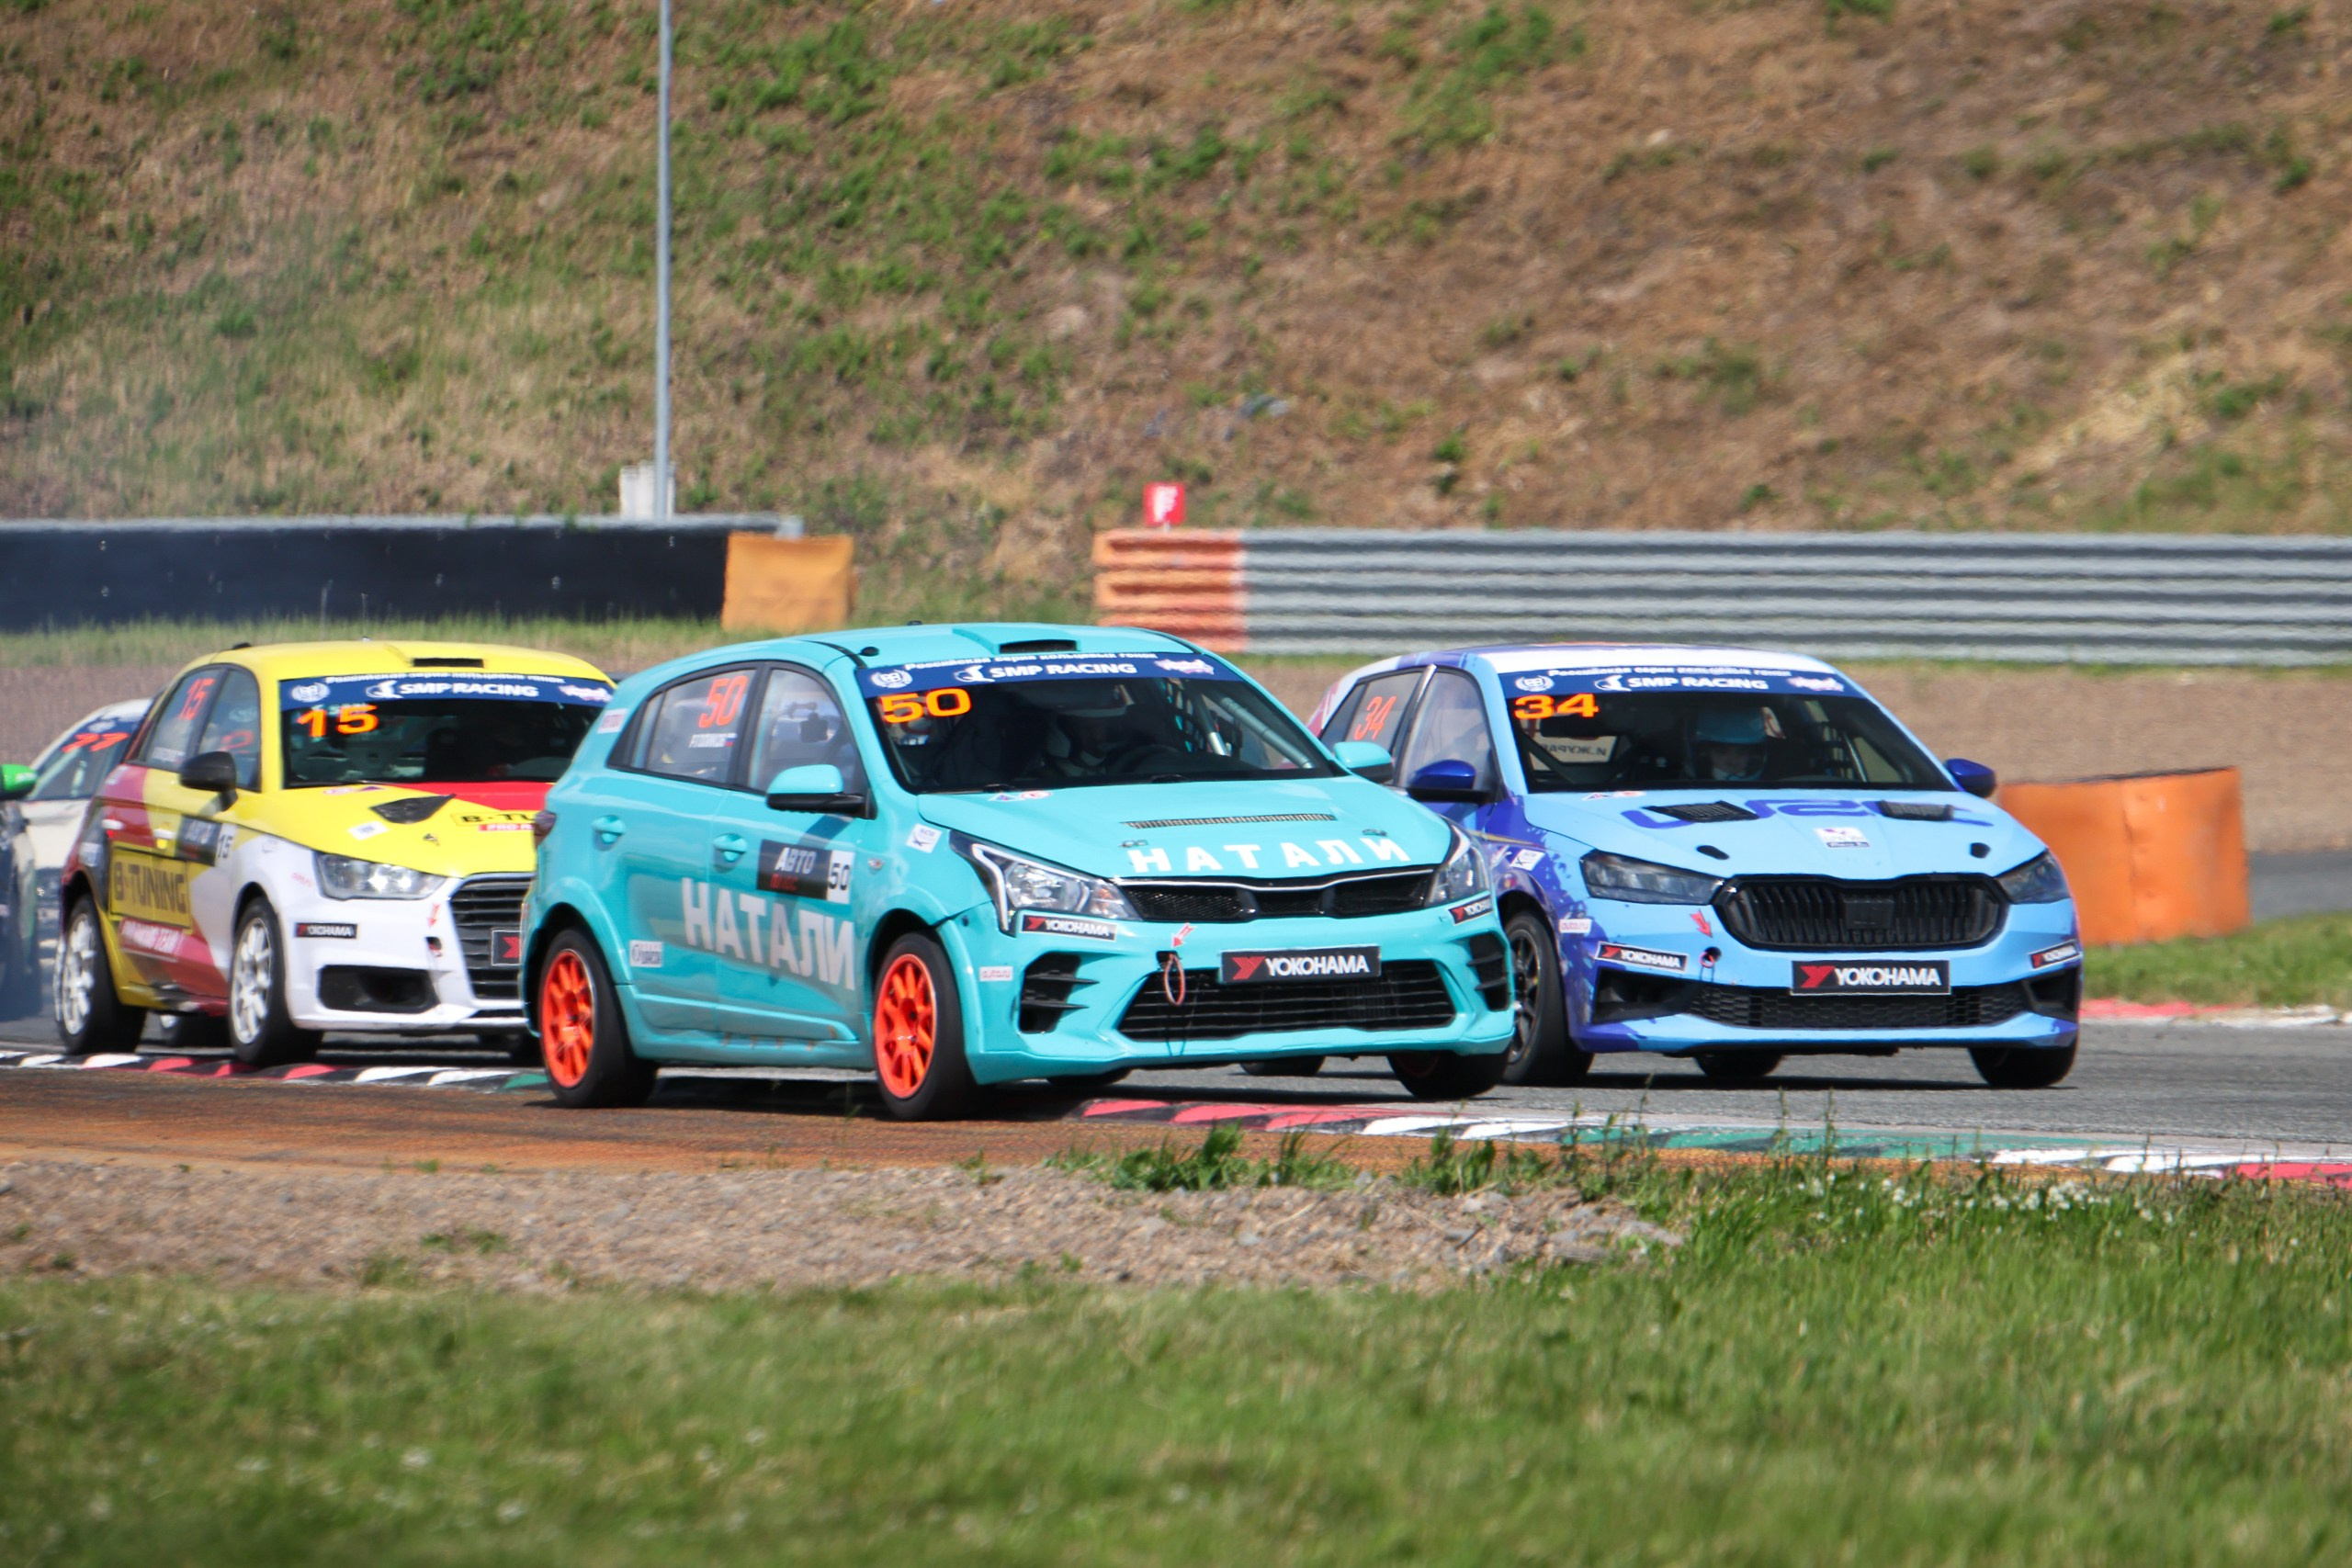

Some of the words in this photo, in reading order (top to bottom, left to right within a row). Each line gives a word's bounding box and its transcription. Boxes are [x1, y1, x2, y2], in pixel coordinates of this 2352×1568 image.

[904, 657, 992, 671] Российская
[994, 653, 1036, 663] серия
[989, 664, 1044, 679] SMP
[1046, 663, 1138, 675] RACING
[398, 682, 453, 695] SMP
[453, 682, 540, 698] RACING
[1627, 677, 1679, 689] SMP
[1680, 676, 1770, 690] RACING
[697, 675, 749, 728] 50
[879, 687, 973, 724] 50
[1514, 693, 1600, 720] 34
[296, 704, 379, 738] 15
[1352, 695, 1397, 741] 34
[217, 834, 233, 859] 15
[1126, 837, 1412, 873] НАТАЛИ
[774, 846, 818, 874] АВТО
[828, 863, 851, 891] 50
[682, 877, 855, 991] НАТАЛИ
[1044, 919, 1110, 938] YOKOHAMA
[1264, 954, 1371, 977] YOKOHAMA
[1619, 947, 1681, 969] YOKOHAMA
[1833, 966, 1942, 987] YOKOHAMA
